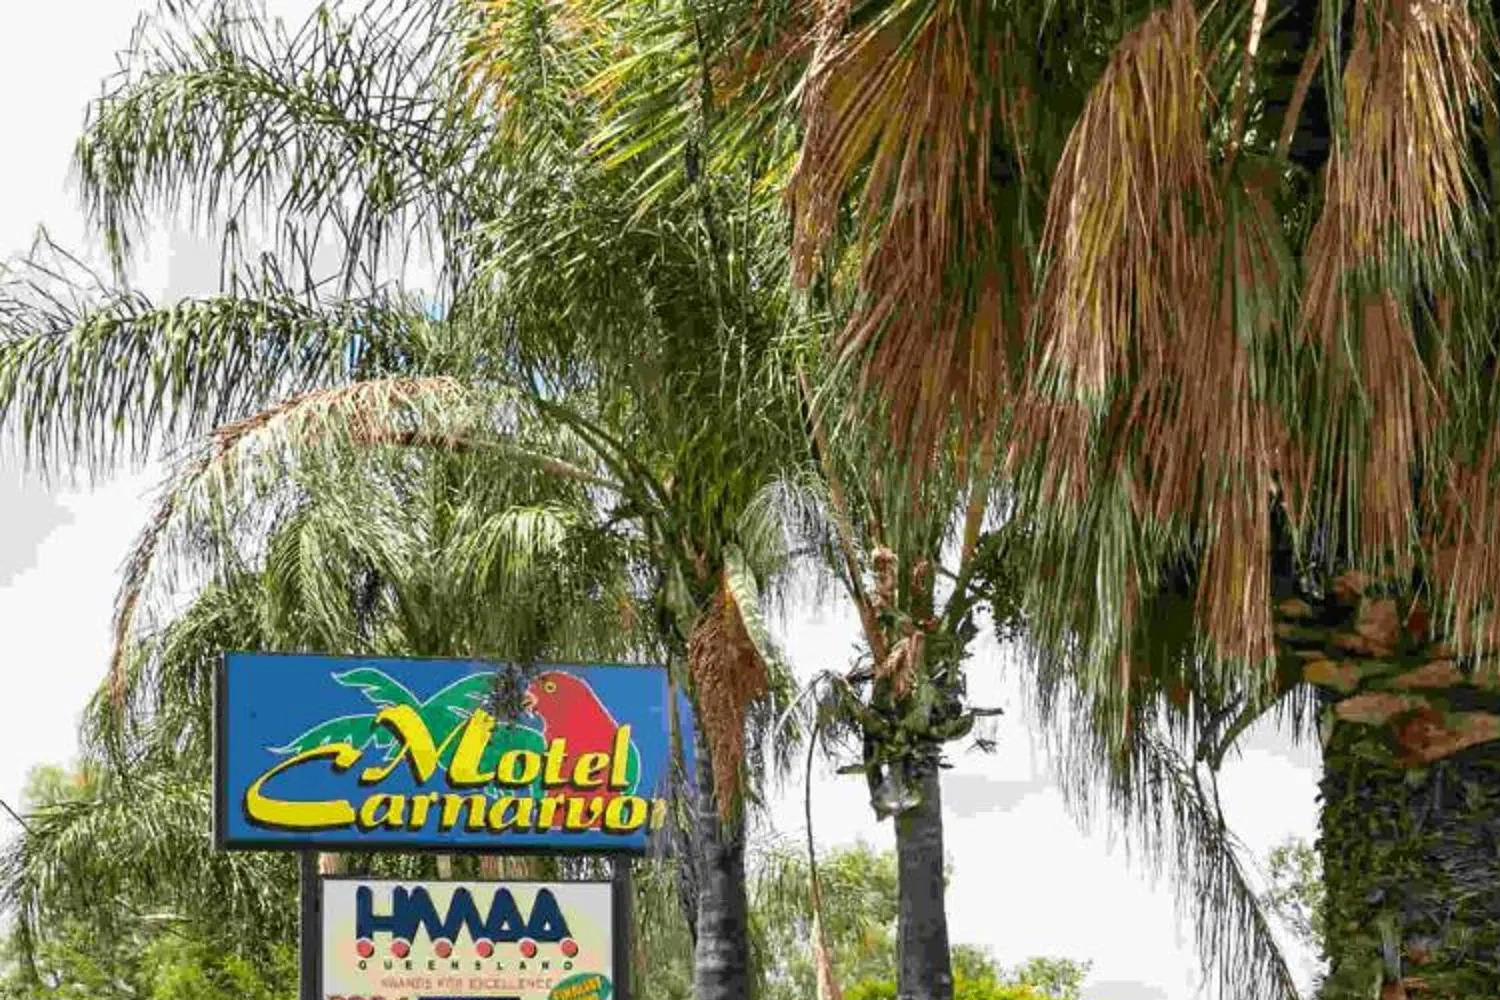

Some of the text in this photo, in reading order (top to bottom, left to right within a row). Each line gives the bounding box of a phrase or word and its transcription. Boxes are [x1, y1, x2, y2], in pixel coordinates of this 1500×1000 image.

[359, 703, 632, 788] Motel
[356, 885, 573, 945] HMAA
[357, 960, 574, 971] QUEENSLAND
